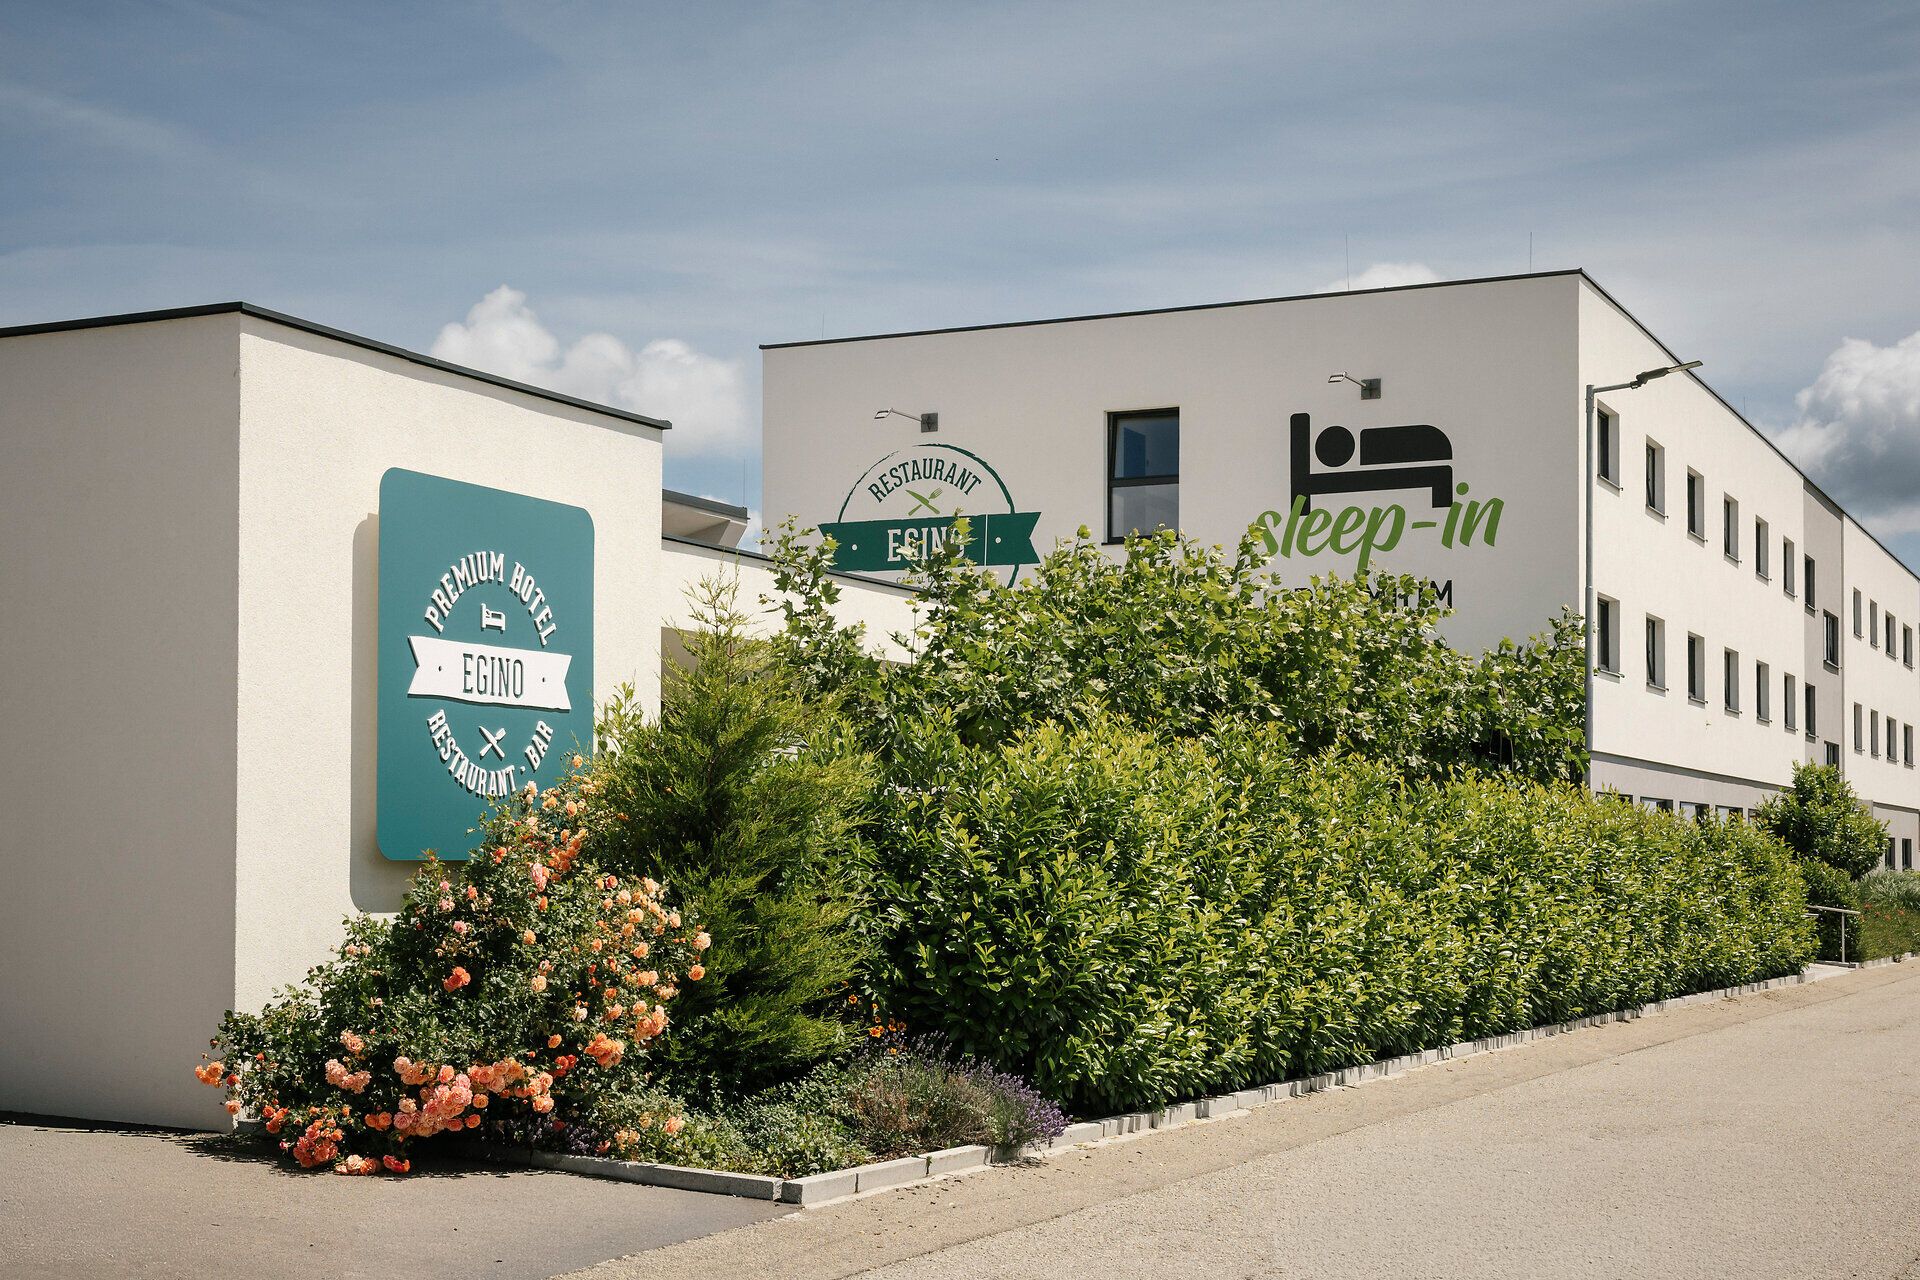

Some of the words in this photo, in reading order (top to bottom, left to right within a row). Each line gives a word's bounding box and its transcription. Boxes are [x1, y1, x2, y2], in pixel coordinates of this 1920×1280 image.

[868, 458, 982, 503] RESTAURANT
[1252, 482, 1504, 572] sleep-in
[424, 550, 505, 633] PREMIUM
[509, 561, 557, 646] HOTEL
[462, 652, 524, 698] EGINO
[427, 709, 517, 797] RESTAURANT
[524, 720, 554, 771] BAR
